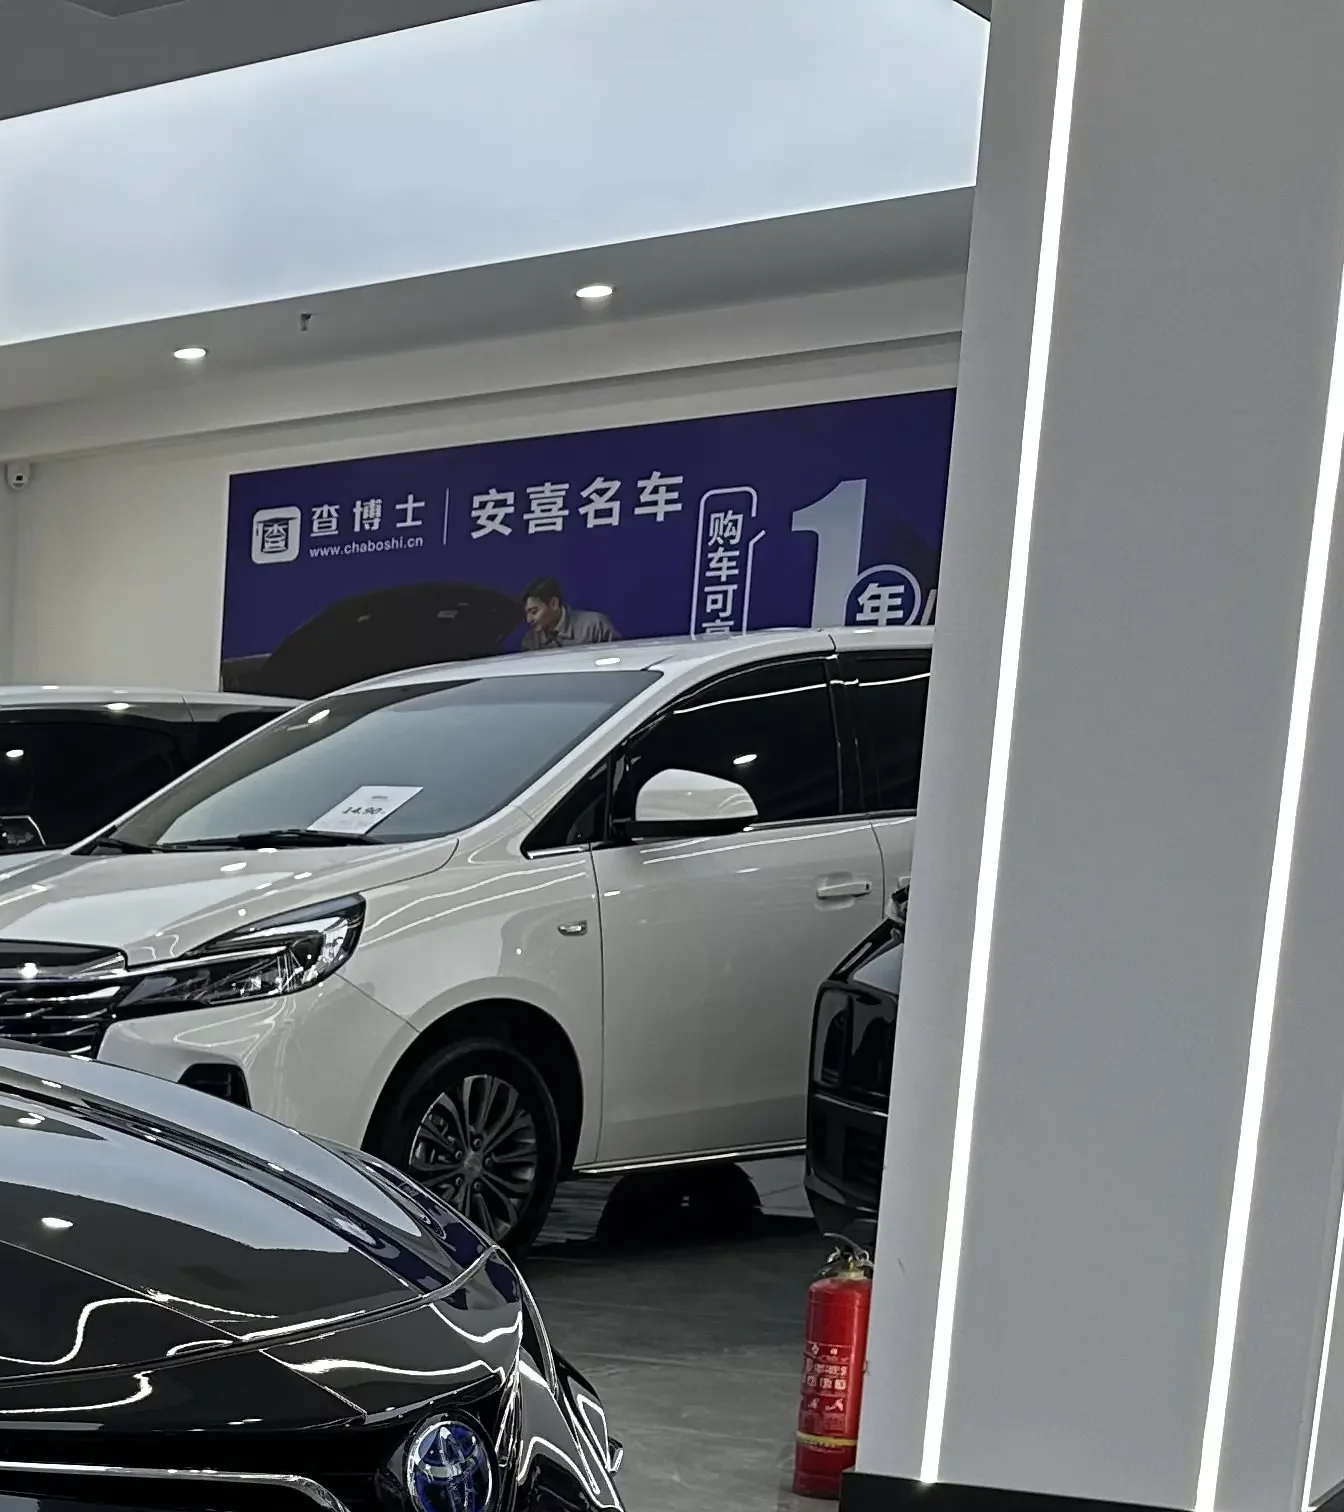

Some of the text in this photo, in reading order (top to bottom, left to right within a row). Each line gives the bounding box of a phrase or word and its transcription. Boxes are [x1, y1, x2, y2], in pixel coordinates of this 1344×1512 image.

[309, 471, 684, 540] 查博士 安喜名车
[308, 535, 424, 558] www.chaboshi.cn
